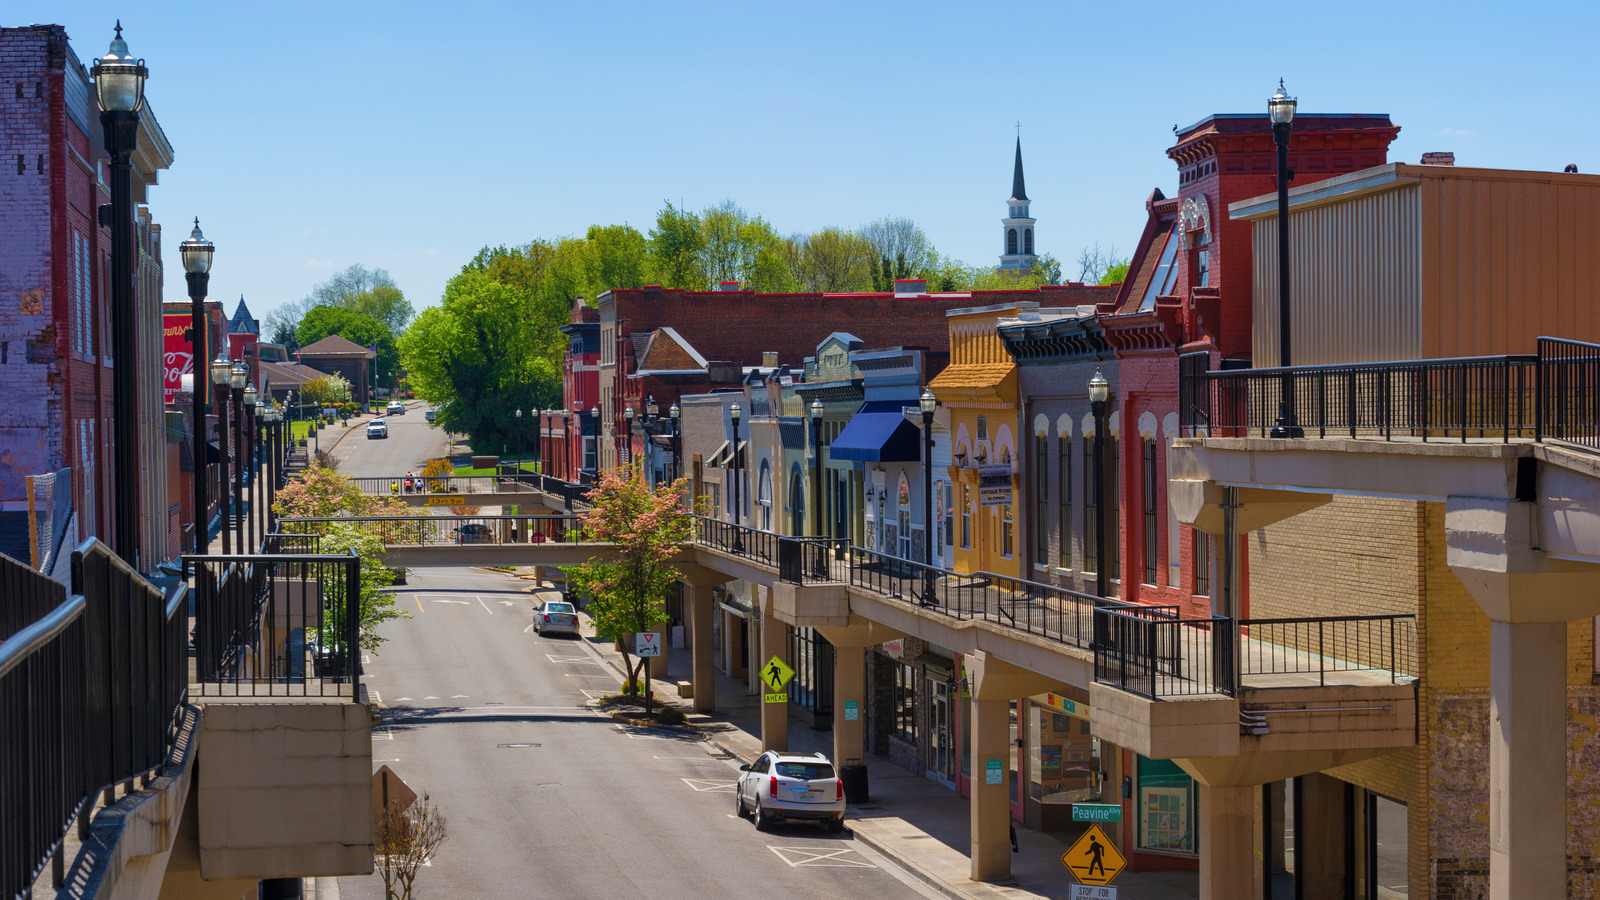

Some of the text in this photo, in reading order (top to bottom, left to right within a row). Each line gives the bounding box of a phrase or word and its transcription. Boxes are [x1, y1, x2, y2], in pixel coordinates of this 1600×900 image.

[1072, 806, 1109, 819] Peavine
[1079, 887, 1109, 897] STOP FOR
